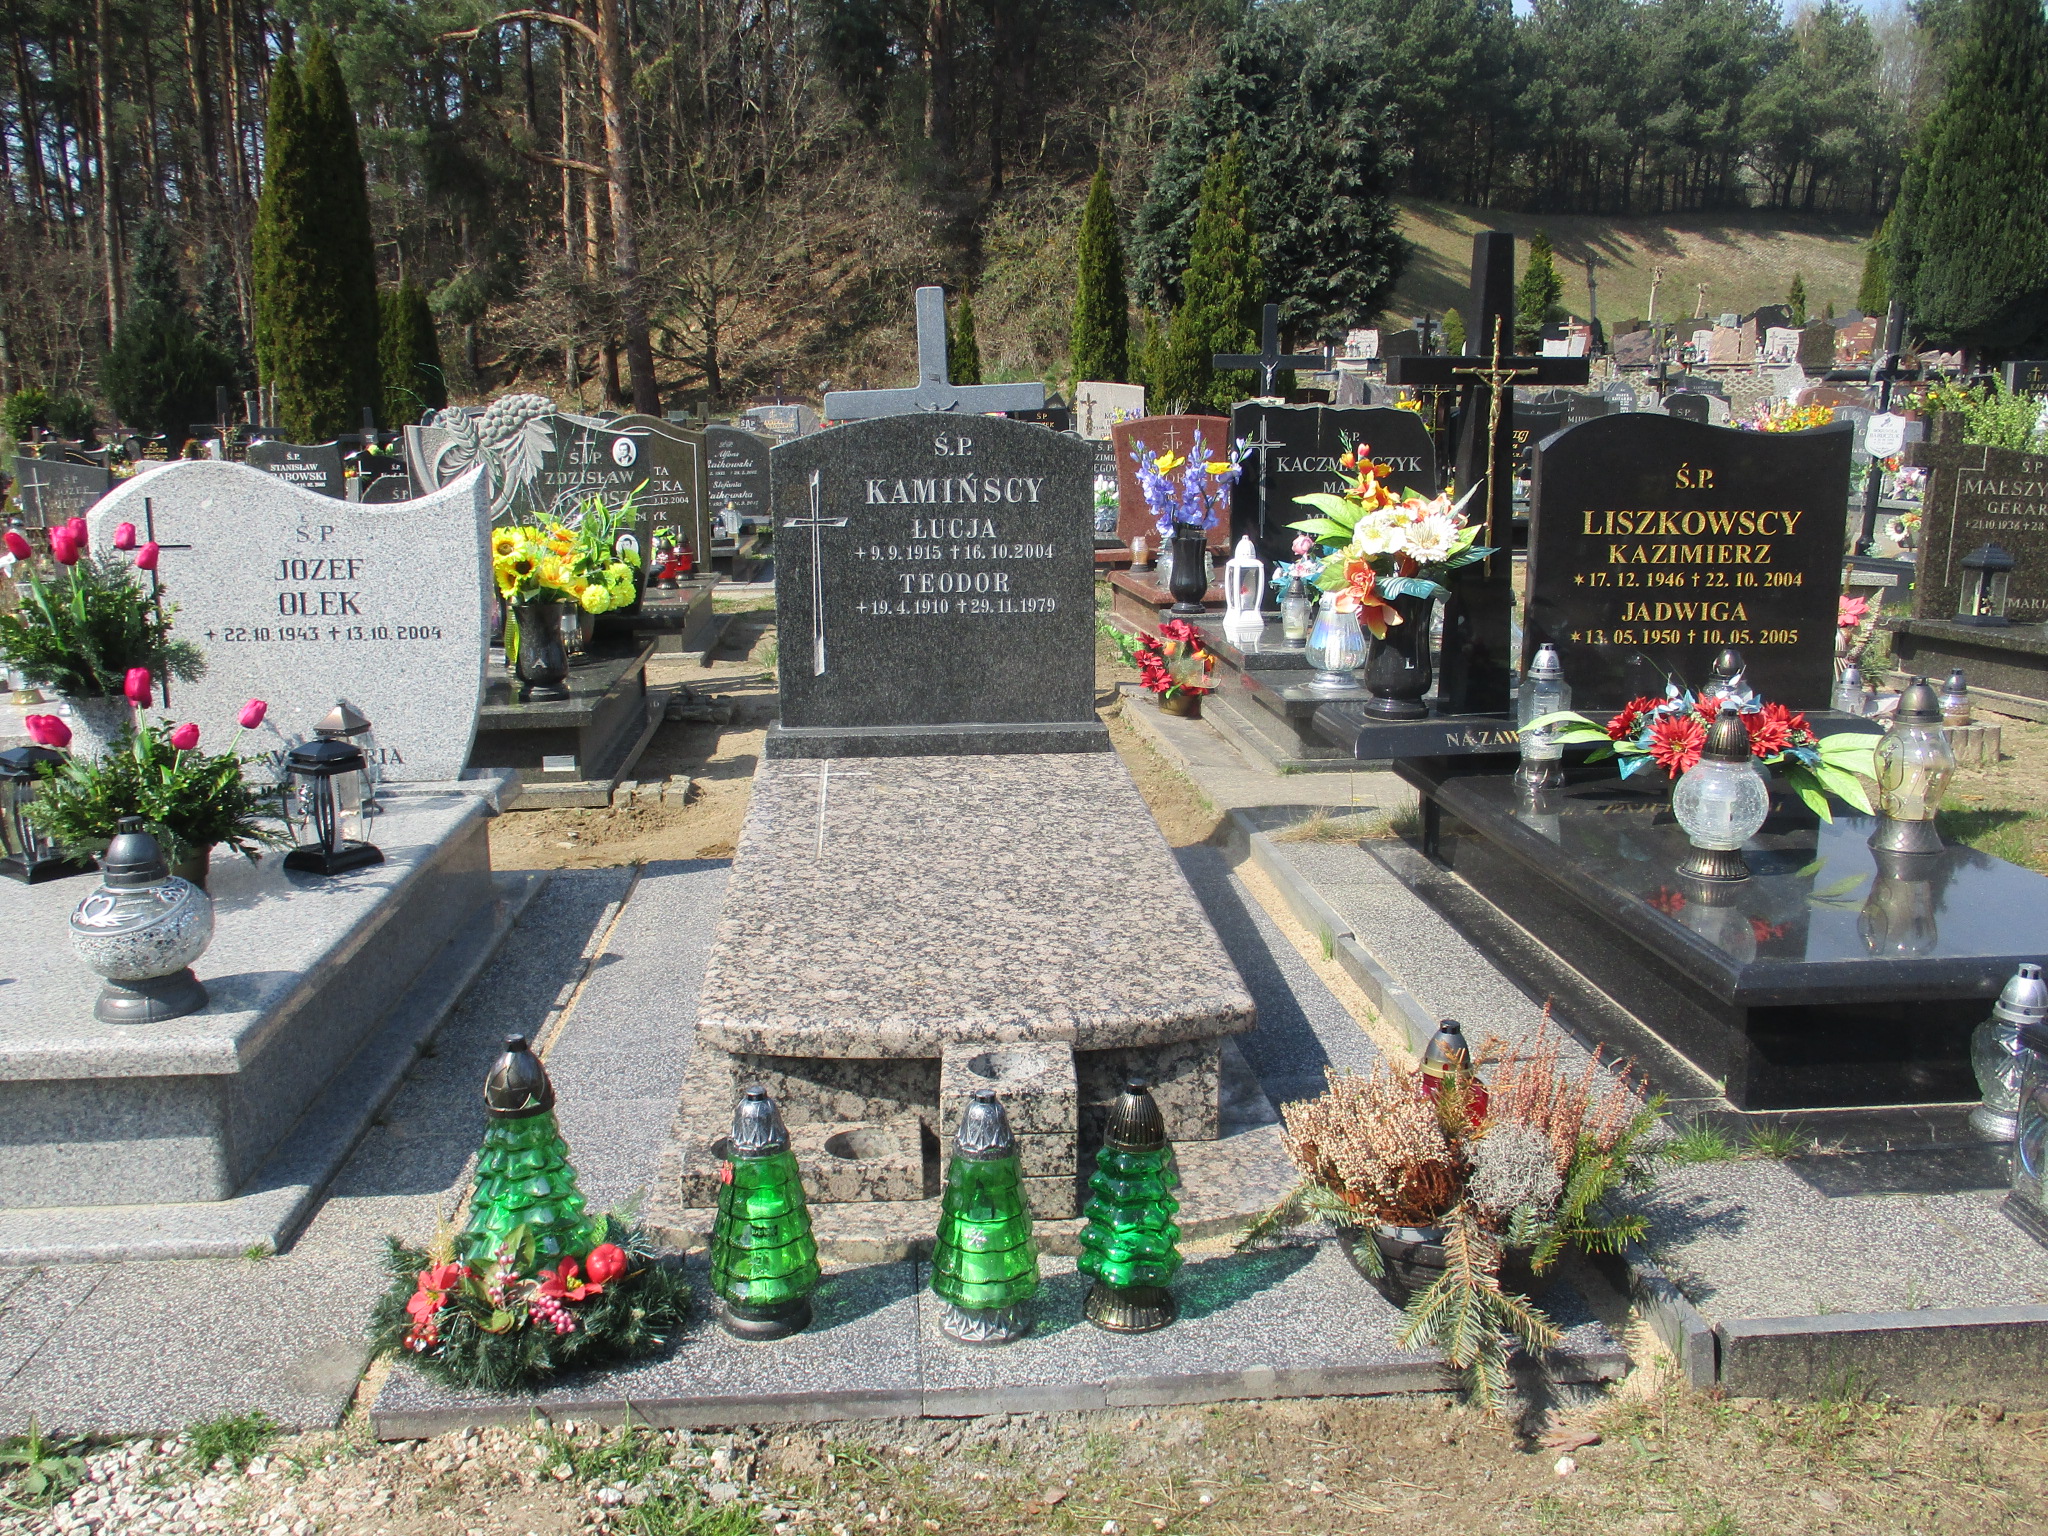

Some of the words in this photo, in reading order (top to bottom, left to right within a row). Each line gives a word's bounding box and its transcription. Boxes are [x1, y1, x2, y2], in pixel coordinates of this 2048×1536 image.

[934, 432, 972, 456] Ś.P.
[270, 463, 318, 471] STANISŁAW
[1276, 456, 1422, 472] KACZMCZYK
[1675, 463, 1714, 489] Ś.P.
[865, 473, 1043, 504] KAMIŃSCY
[911, 518, 996, 539] ŁUCJA
[1581, 510, 1803, 536] LISZKOWSCY
[1608, 544, 1771, 564] KAZIMIERZ
[899, 573, 1009, 593] TEODOR
[279, 592, 362, 616] OLEK
[1621, 602, 1748, 622] JADWIGA
[1478, 730, 1520, 746] ZAW
